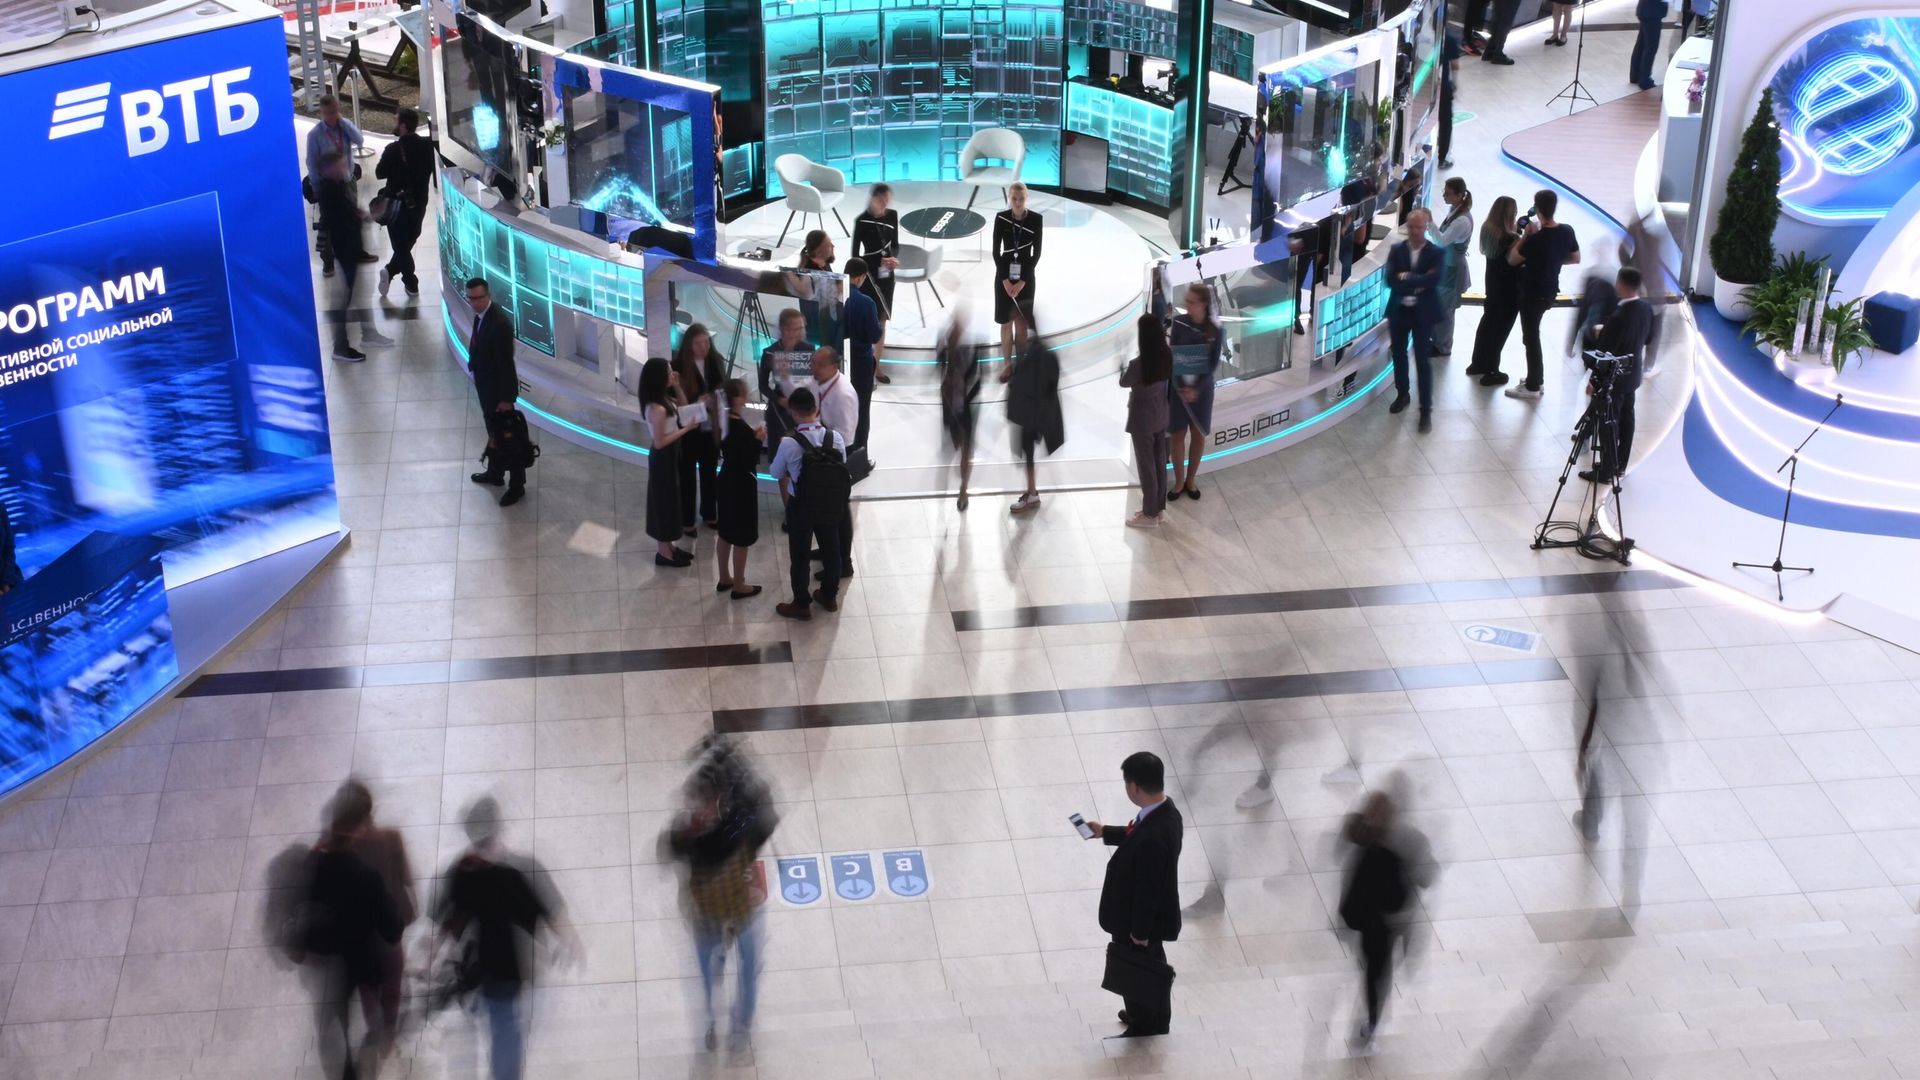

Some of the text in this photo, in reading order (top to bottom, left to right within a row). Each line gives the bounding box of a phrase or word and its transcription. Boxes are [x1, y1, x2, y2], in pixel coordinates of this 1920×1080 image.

[120, 66, 260, 158] ВТБ
[0, 307, 173, 370] ТИВНОЙ СОЦИАЛЬНОЙ
[788, 865, 806, 878] D
[843, 861, 860, 876] C
[895, 857, 912, 872] B
